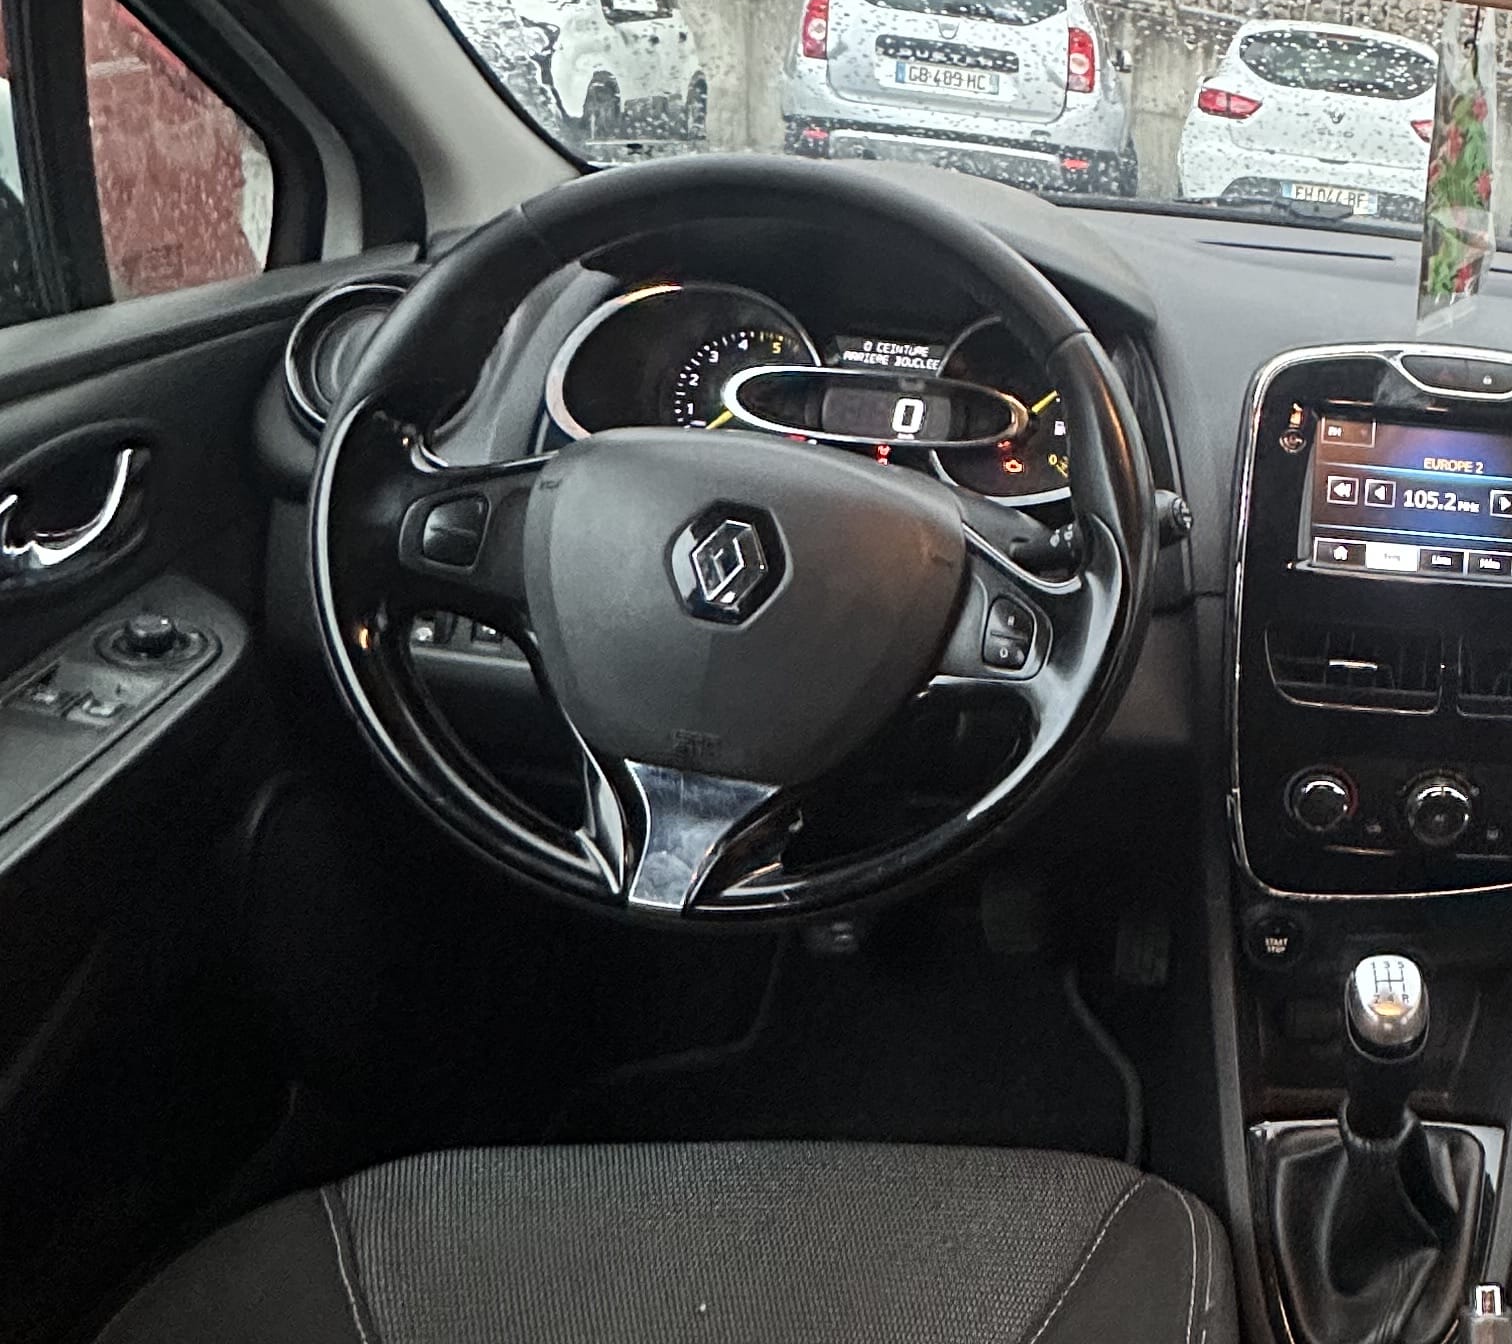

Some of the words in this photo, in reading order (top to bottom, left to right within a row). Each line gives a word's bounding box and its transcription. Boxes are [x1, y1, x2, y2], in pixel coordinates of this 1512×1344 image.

[738, 339, 748, 350] 4
[772, 341, 781, 354] 5
[708, 350, 719, 363] 3
[688, 373, 700, 386] 2
[687, 403, 694, 415] 1
[892, 398, 925, 433] 0
[1424, 457, 1473, 472] EUROPE
[1475, 462, 1484, 475] 2
[1403, 489, 1457, 512] 105.2
[1265, 937, 1289, 947] START
[1267, 945, 1286, 953] STOP
[1370, 960, 1377, 970] 1
[1383, 960, 1391, 969] 3
[1397, 960, 1405, 969] 5
[1401, 994, 1410, 1004] R
